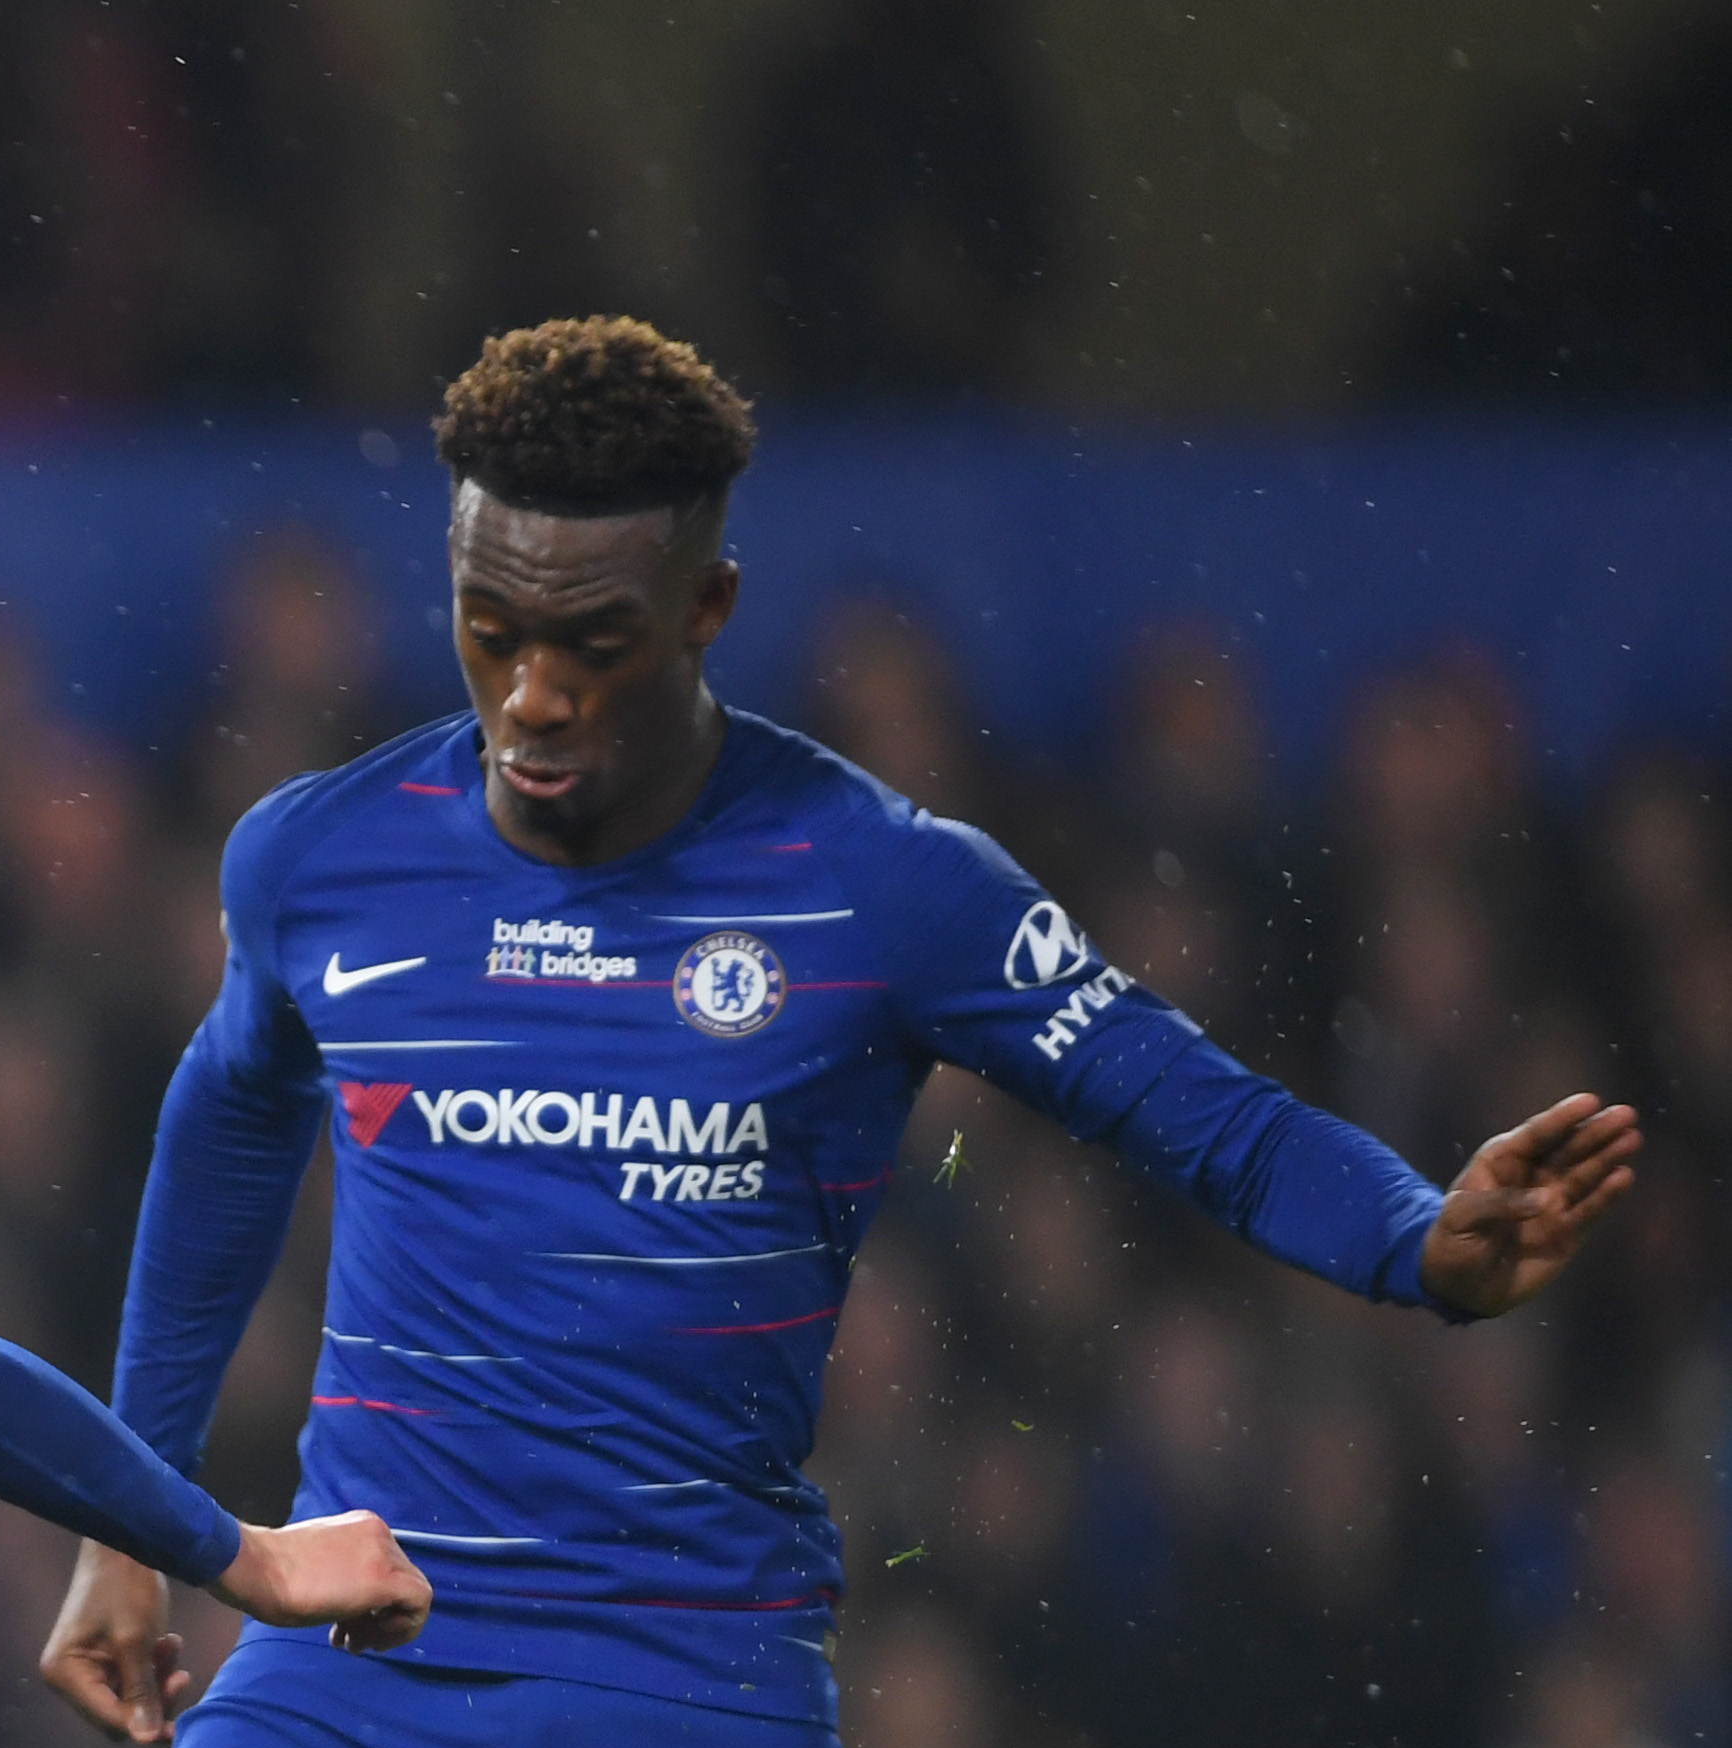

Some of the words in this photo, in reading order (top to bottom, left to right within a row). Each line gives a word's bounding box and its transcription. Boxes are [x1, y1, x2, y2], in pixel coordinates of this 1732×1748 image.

[493, 917, 594, 952] building
[695, 935, 766, 960] CHELSEA
[540, 950, 637, 983] bridges
[1031, 965, 1136, 1061] HYUN
[412, 1088, 769, 1154] YOKOHAMA
[618, 1160, 766, 1202] TYRES
